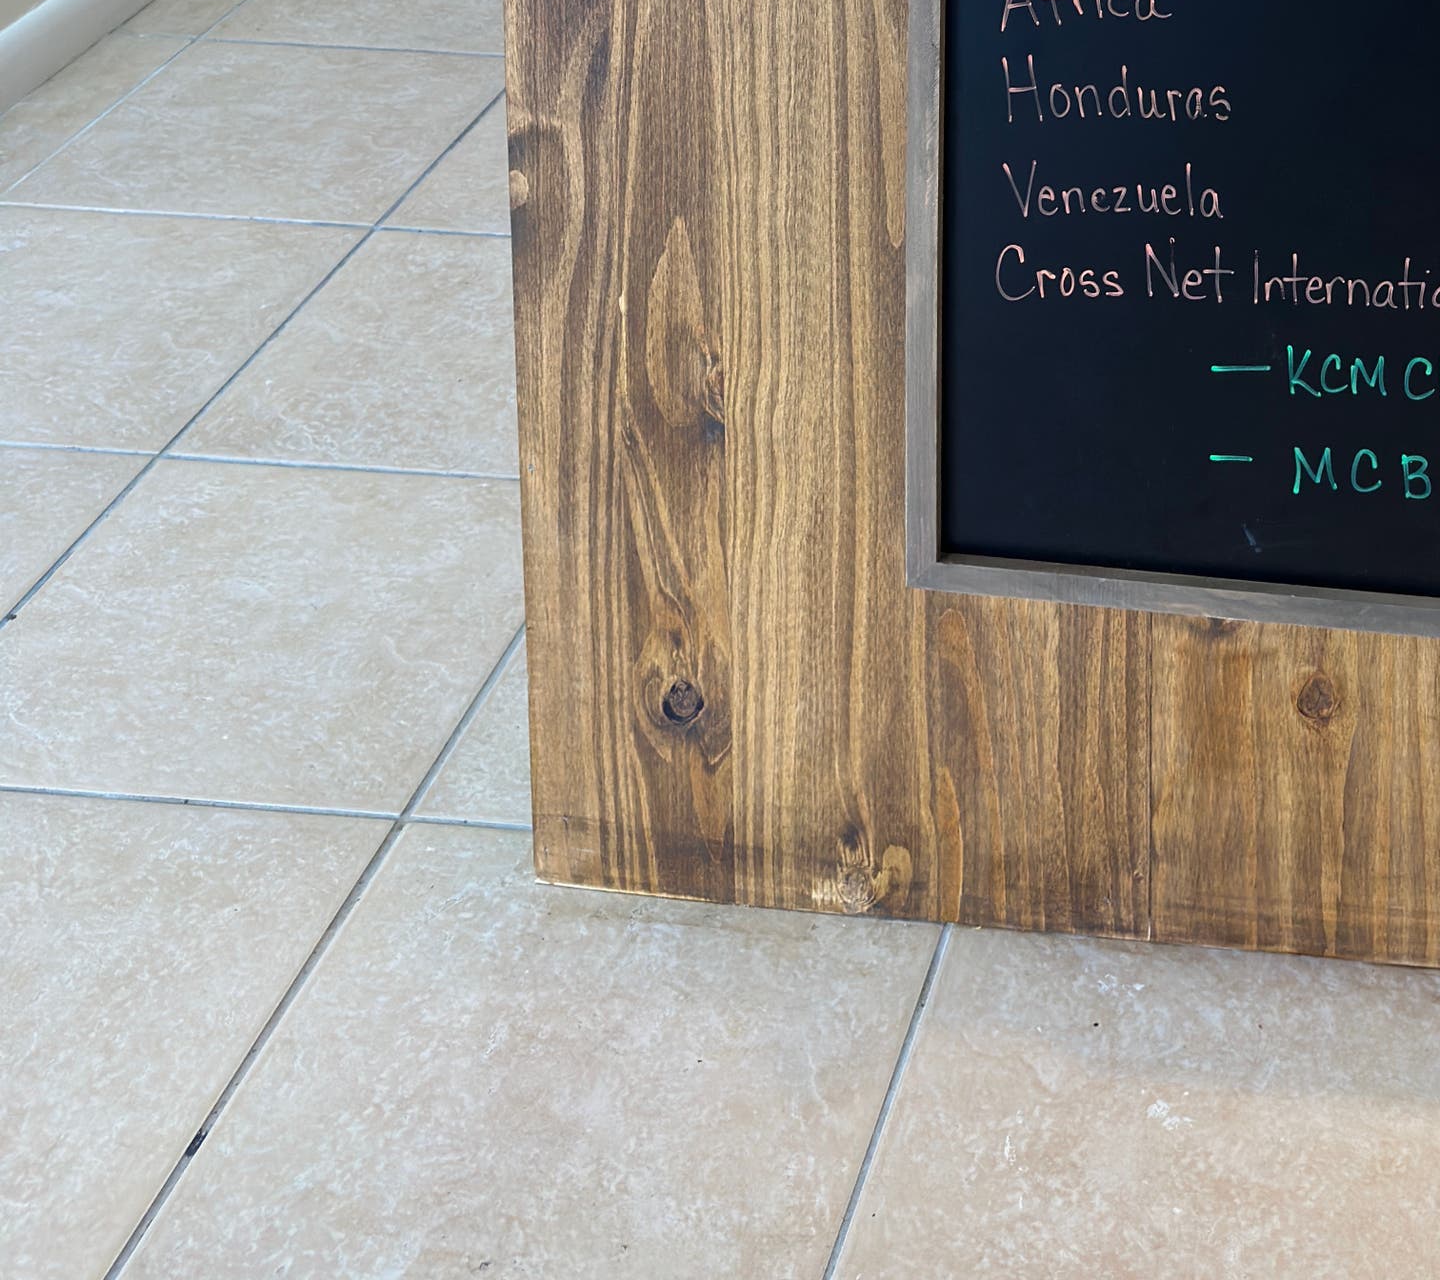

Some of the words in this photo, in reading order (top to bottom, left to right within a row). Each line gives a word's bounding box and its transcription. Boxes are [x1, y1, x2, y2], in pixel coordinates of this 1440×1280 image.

[1001, 54, 1231, 123] Honduras
[1003, 159, 1224, 220] Venezuela
[995, 243, 1124, 304] Cross
[1144, 237, 1234, 304] Net
[1287, 344, 1388, 399] KCM
